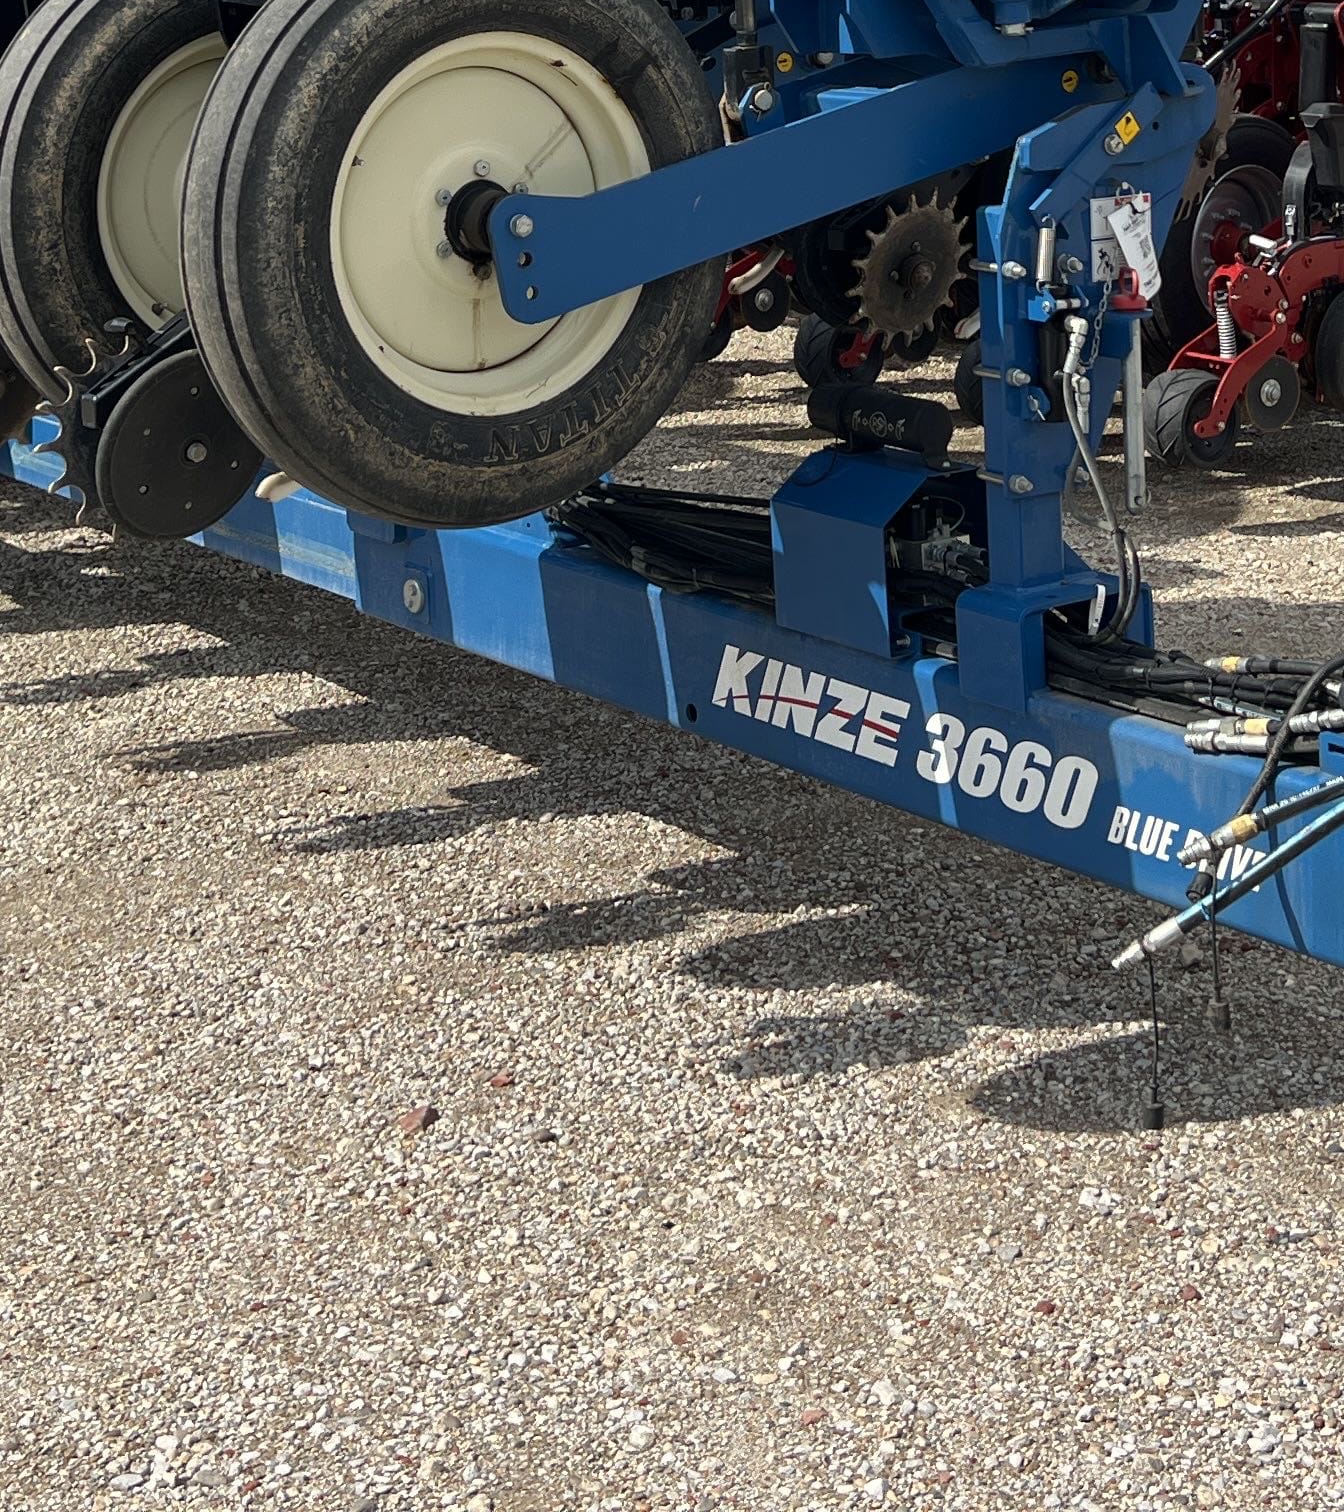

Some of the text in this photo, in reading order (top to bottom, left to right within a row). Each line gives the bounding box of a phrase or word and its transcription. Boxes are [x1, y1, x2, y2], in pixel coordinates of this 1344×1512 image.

[484, 358, 642, 462] TITAN
[712, 644, 1099, 829] KINZE 3660
[1107, 805, 1180, 862] BLUE
